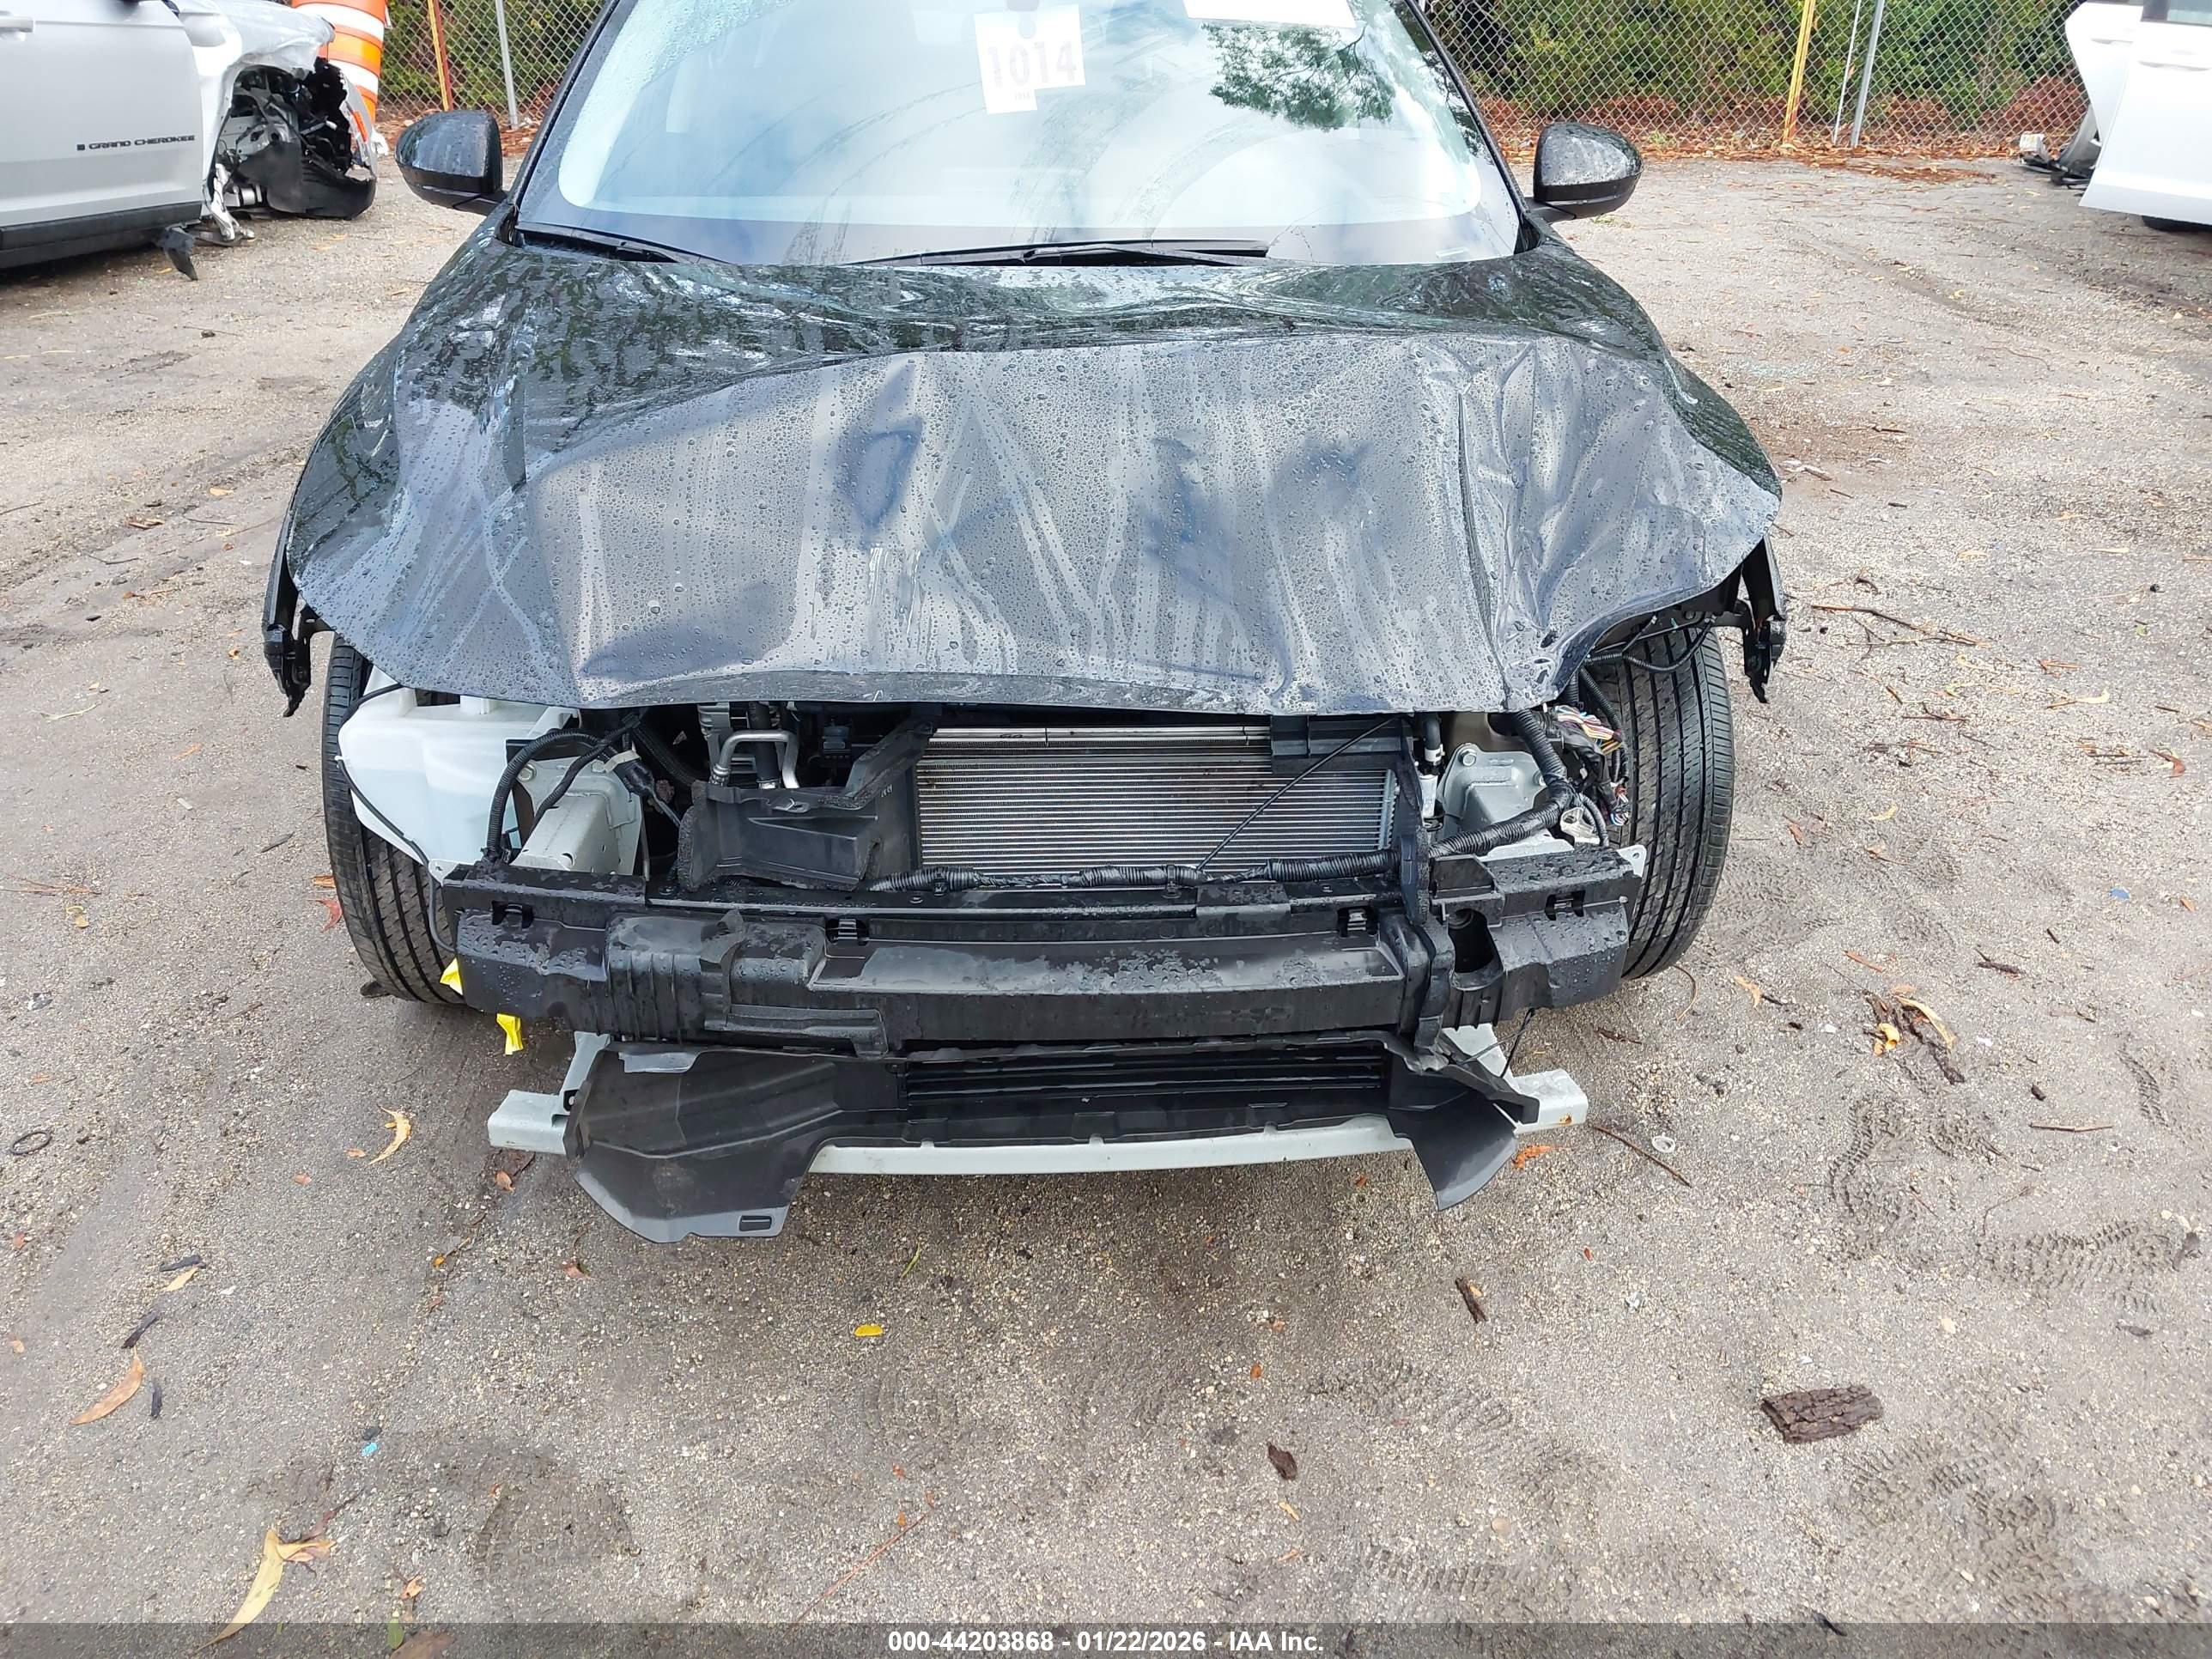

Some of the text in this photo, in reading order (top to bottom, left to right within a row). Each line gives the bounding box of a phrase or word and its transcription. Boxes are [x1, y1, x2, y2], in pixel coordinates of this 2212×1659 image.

[988, 41, 1077, 88] 1014
[88, 135, 196, 150] GRAND CHEROKEE
